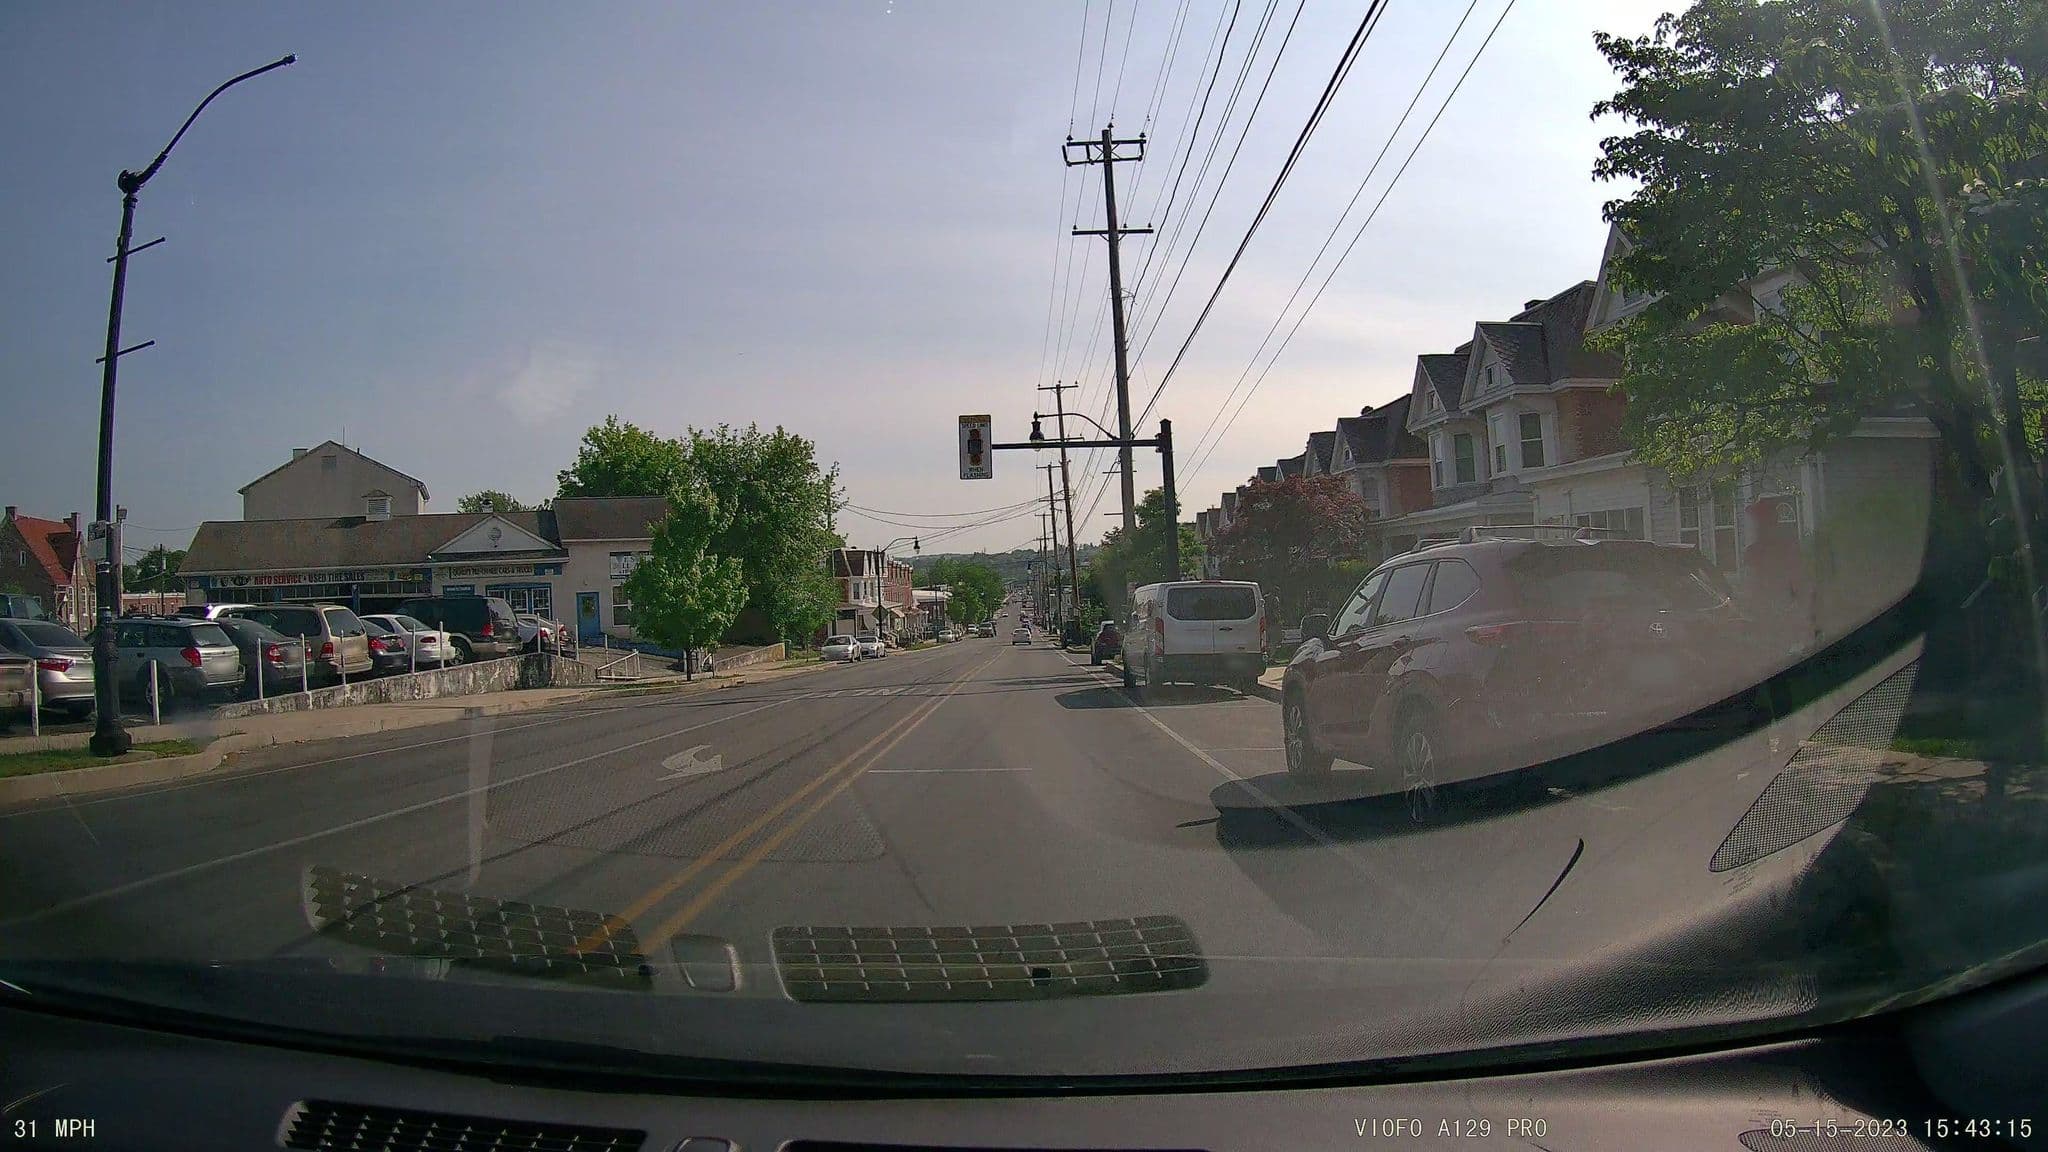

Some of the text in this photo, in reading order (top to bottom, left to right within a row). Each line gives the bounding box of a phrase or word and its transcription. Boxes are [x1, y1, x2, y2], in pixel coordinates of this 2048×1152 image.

[254, 575, 272, 585] AUTO
[273, 574, 303, 584] SERVICE
[308, 573, 327, 583] USED
